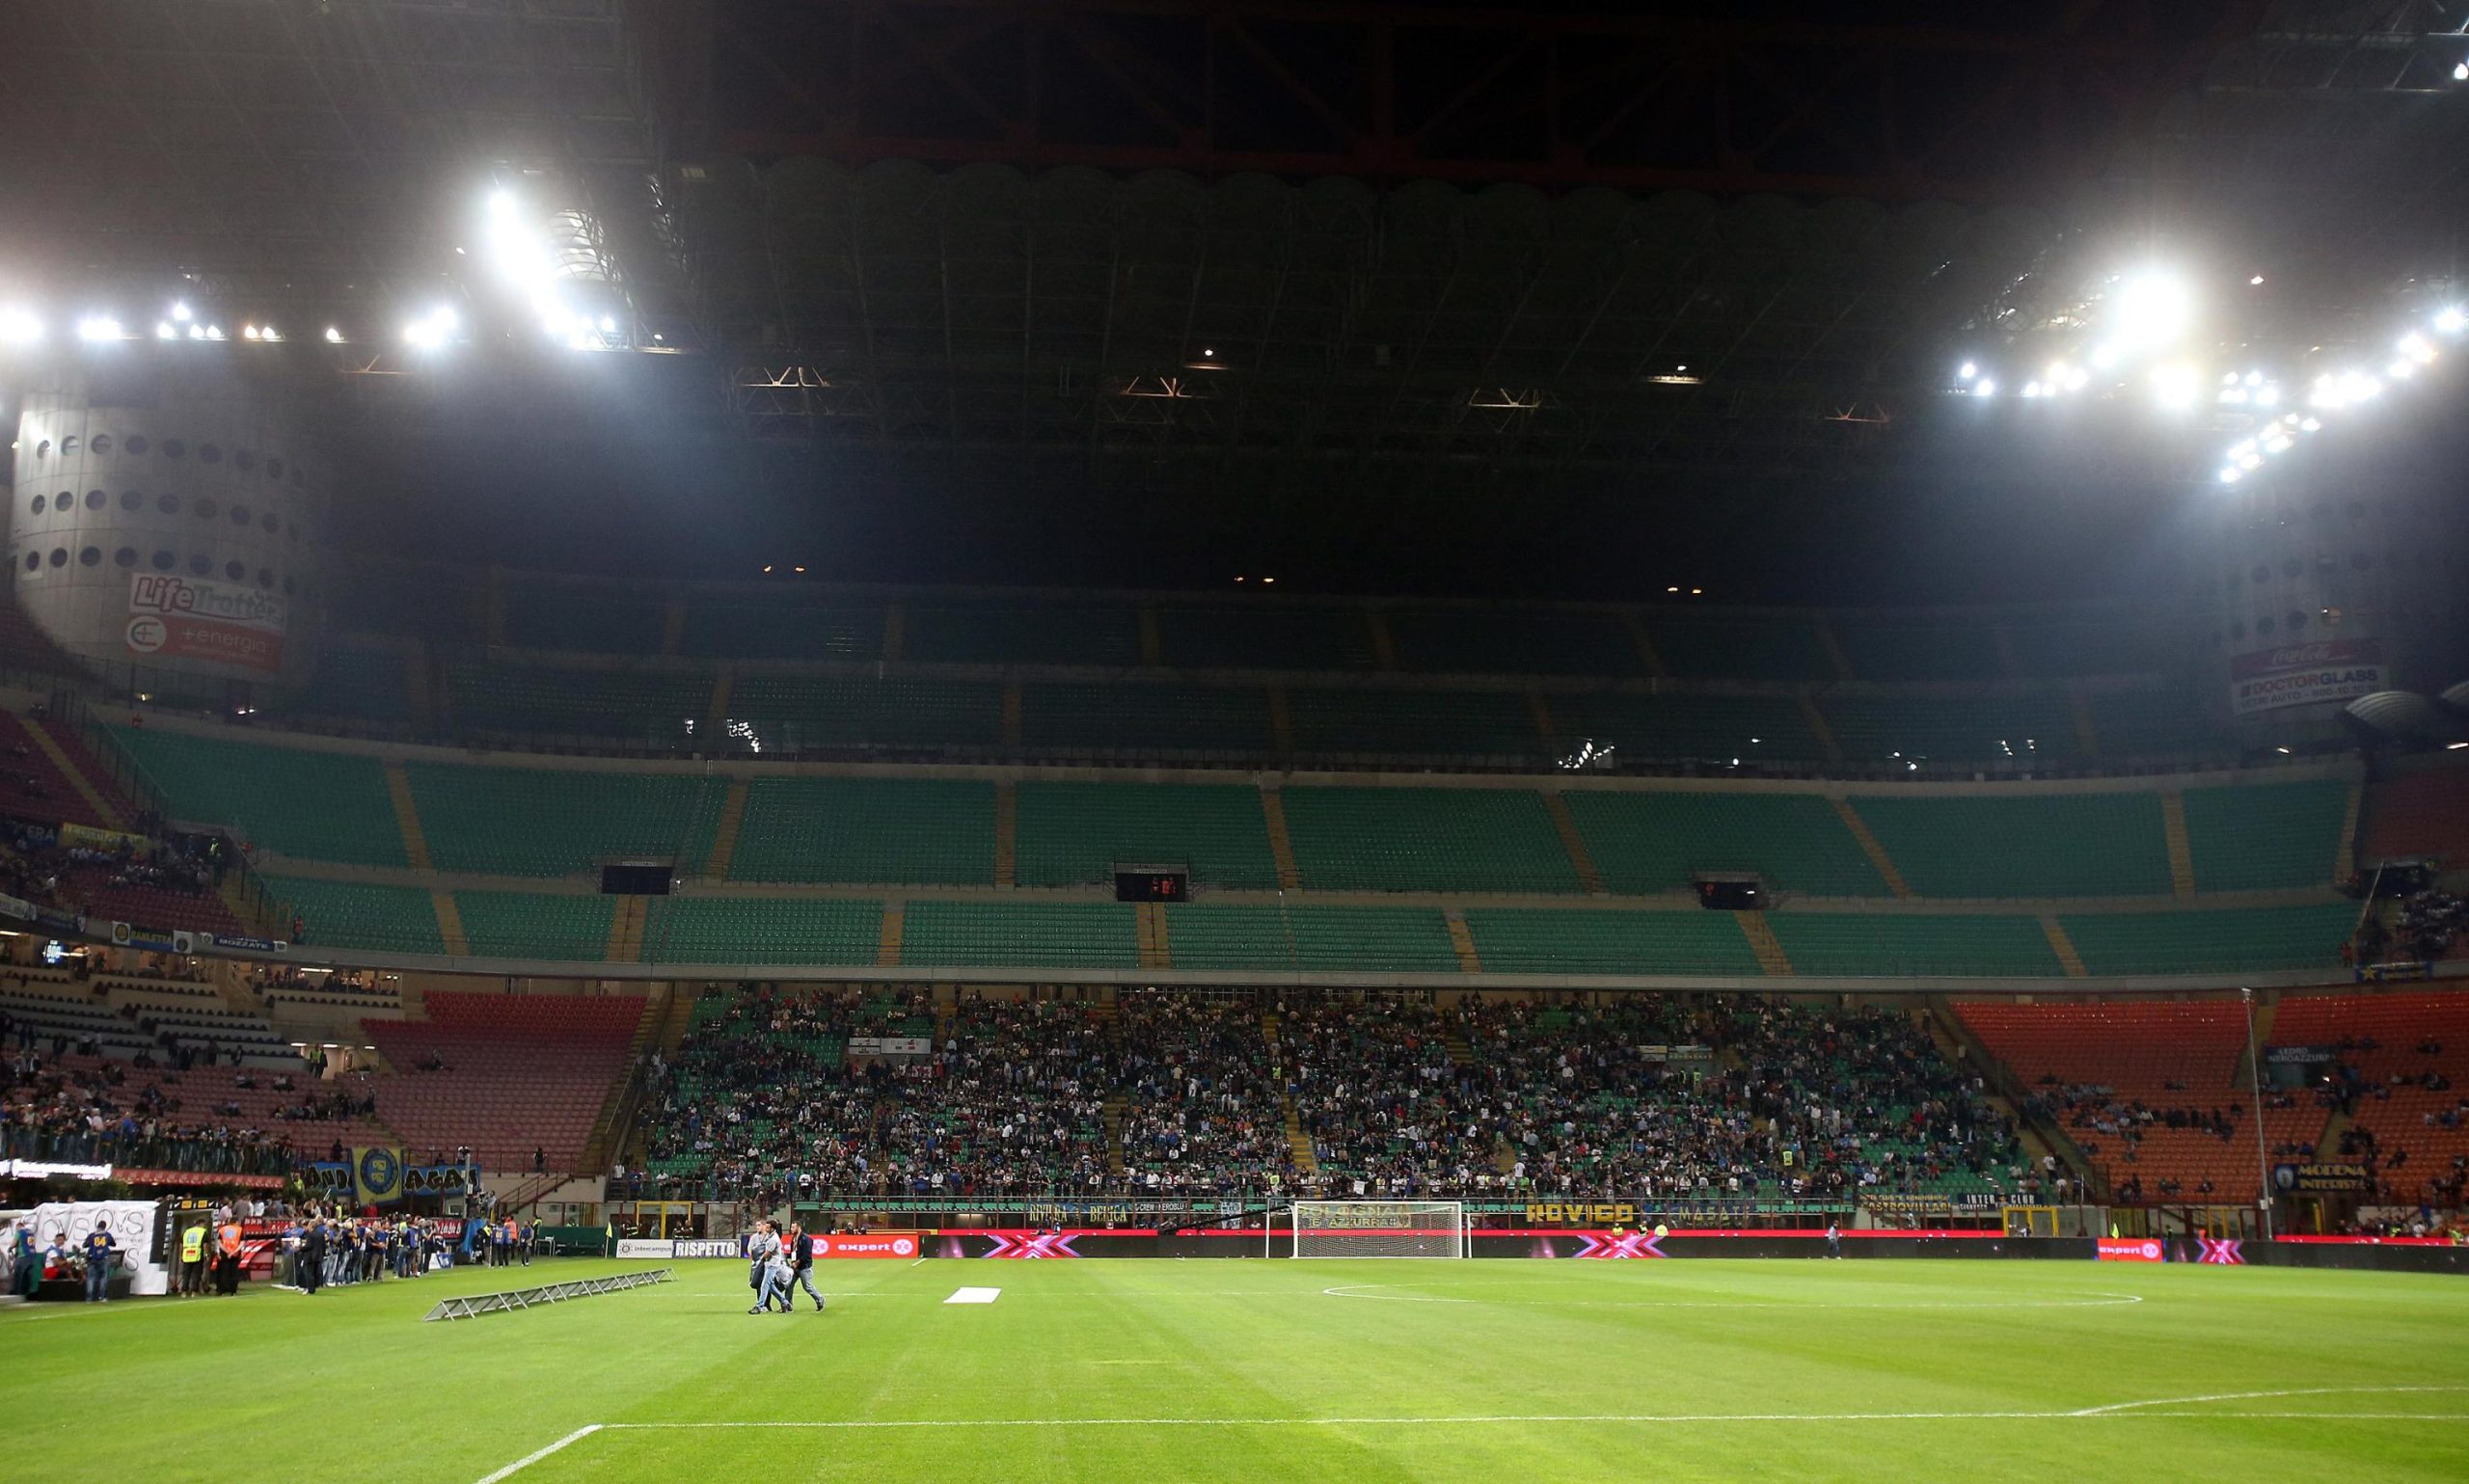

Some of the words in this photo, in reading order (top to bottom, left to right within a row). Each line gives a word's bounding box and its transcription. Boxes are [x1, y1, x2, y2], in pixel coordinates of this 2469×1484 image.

[2298, 1164, 2367, 1175] MODENA
[1967, 1194, 1995, 1204] INTER
[2011, 1194, 2035, 1204] CLUB
[1527, 1204, 1634, 1222] ROVIGO
[634, 1244, 672, 1255] intercampus
[675, 1241, 736, 1257] RISPETTO
[837, 1242, 892, 1252] expert
[2099, 1247, 2140, 1255] expert
